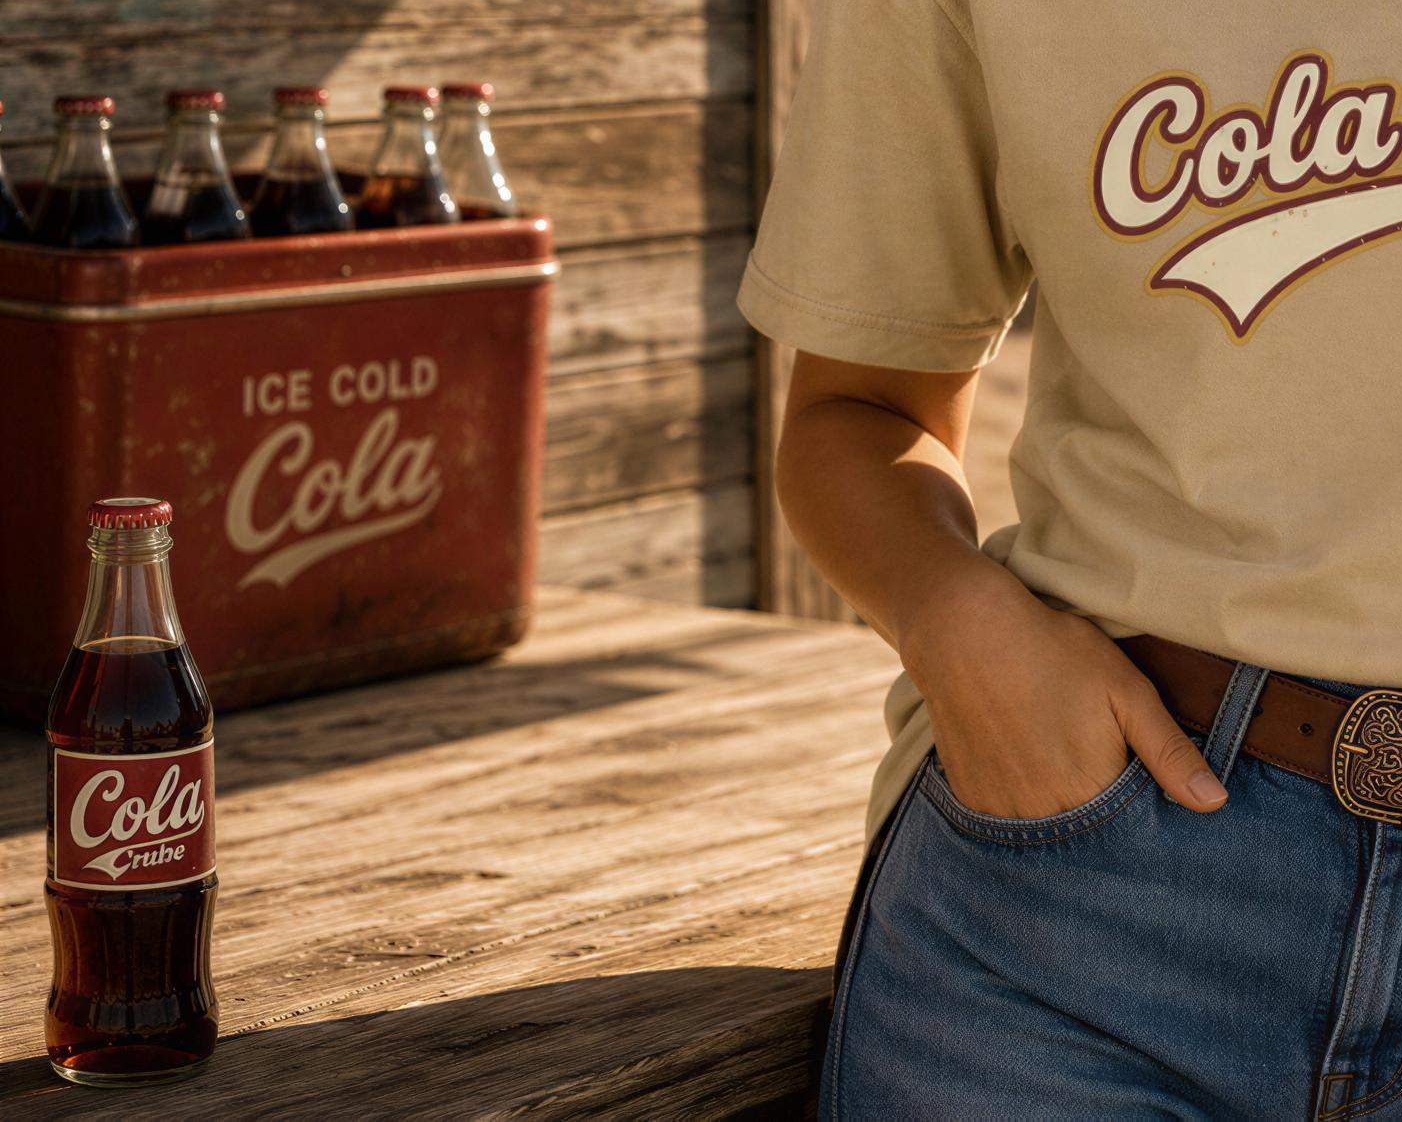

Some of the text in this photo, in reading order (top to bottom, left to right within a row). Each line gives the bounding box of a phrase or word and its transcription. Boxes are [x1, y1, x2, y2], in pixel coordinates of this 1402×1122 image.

[242, 355, 439, 418] ICE COLD
[225, 407, 443, 554] Cola
[70, 763, 205, 849] Cola
